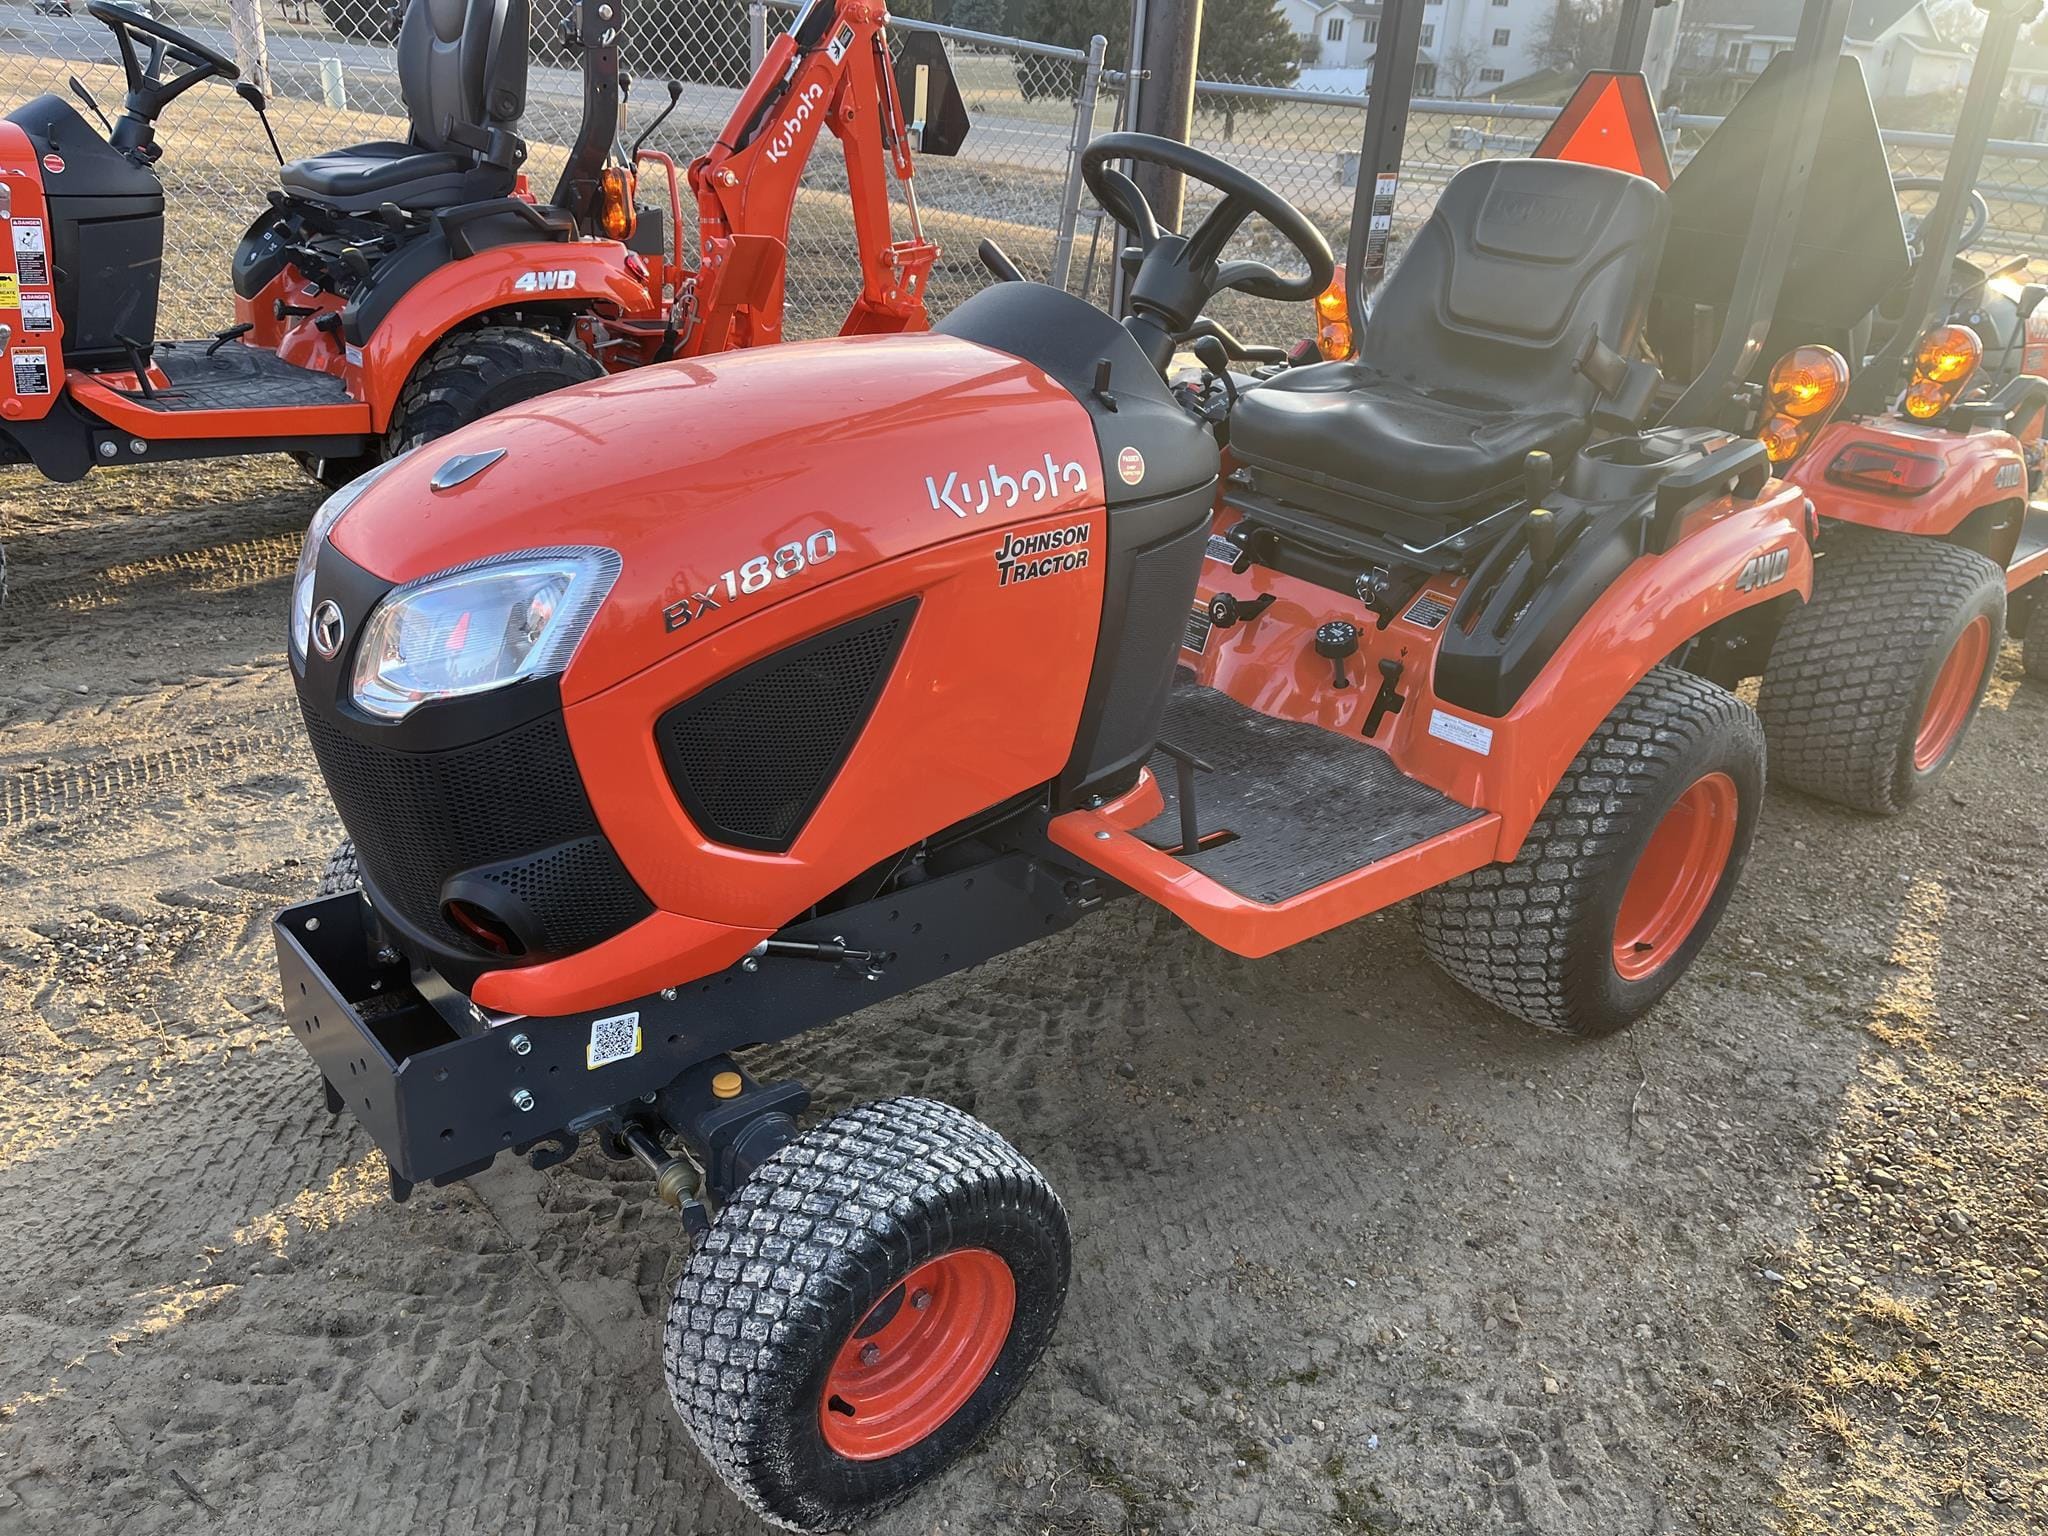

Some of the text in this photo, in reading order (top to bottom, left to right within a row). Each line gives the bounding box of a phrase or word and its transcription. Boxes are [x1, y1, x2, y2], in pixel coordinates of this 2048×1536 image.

[766, 83, 824, 164] Kubota
[514, 269, 577, 292] 4WD
[925, 453, 1088, 519] Kubota
[995, 524, 1090, 561] JOHNSON
[998, 549, 1088, 587] TRACTOR
[1735, 548, 1789, 592] 4WD
